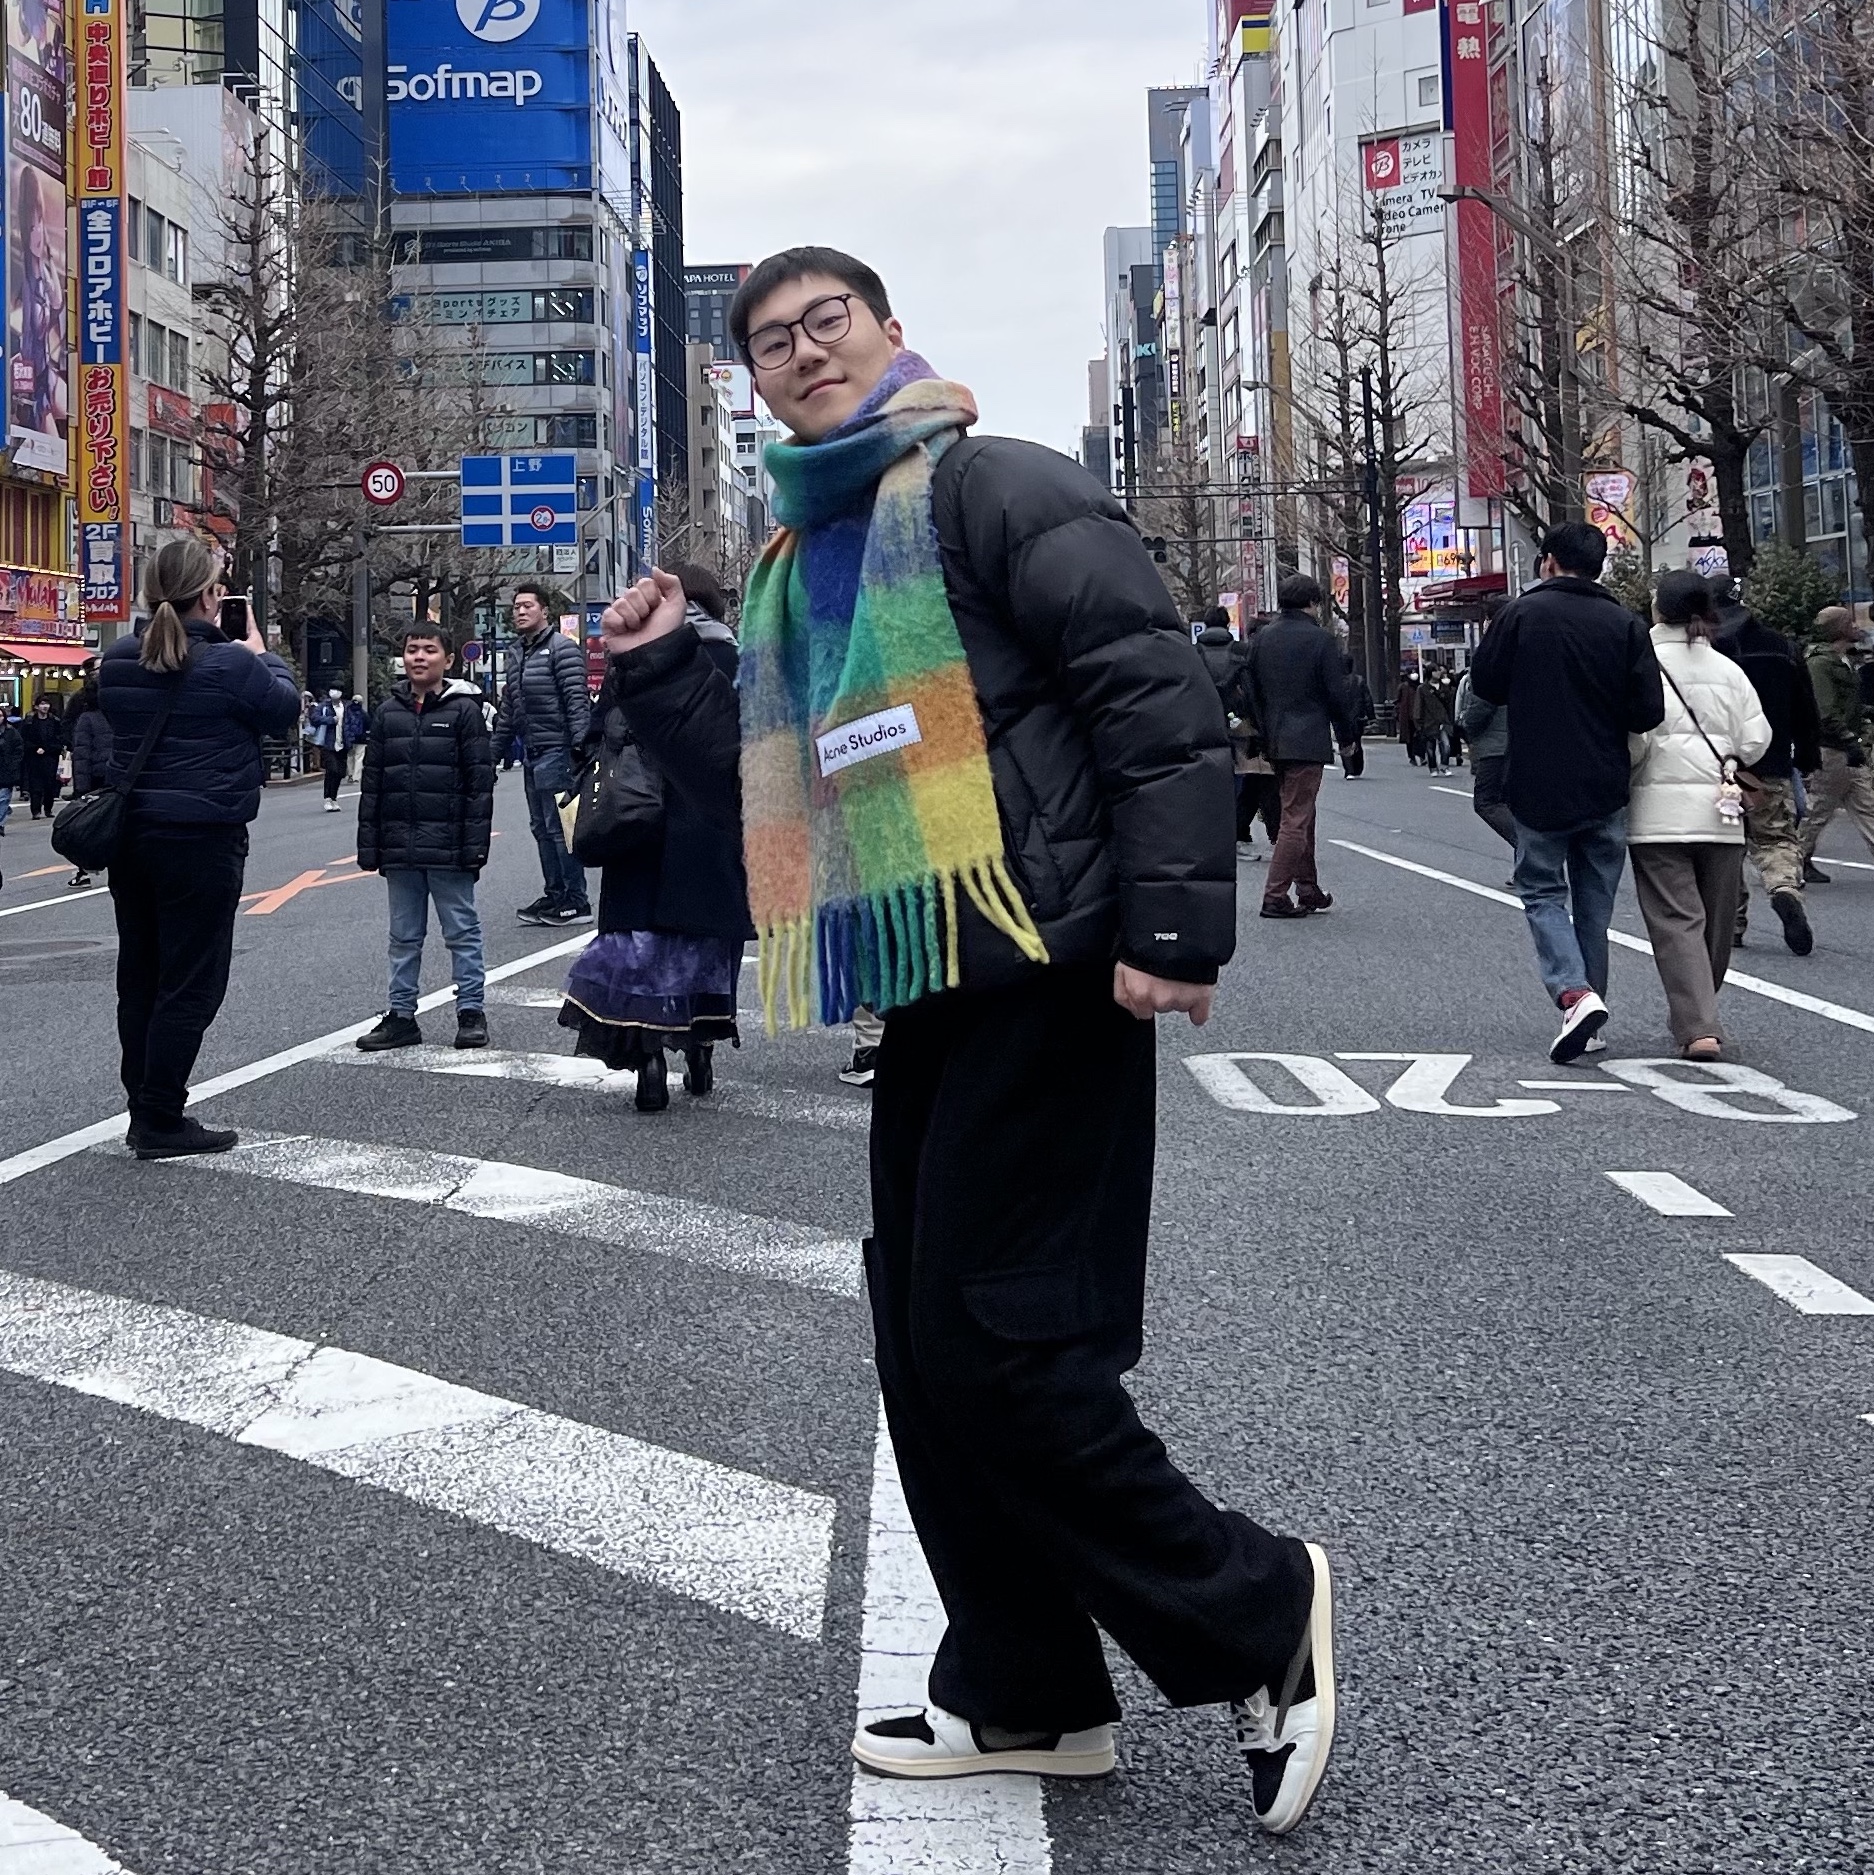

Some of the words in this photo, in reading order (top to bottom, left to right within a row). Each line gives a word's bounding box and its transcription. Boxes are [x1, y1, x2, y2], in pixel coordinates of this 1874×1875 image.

[386, 63, 543, 106] Sofmap
[86, 21, 111, 191] 中央通りホビー館
[1403, 138, 1431, 153] カメラ
[1403, 154, 1432, 169] テレビ
[1421, 188, 1435, 200] TV
[1408, 204, 1444, 217] Camer
[703, 272, 736, 283] HOTEL
[87, 209, 113, 363] 全フロアホビー
[512, 458, 543, 472] 上野
[372, 474, 395, 493] 50
[85, 523, 118, 540] 2F
[642, 506, 653, 569] Sofmap
[88, 541, 116, 585] 買取
[86, 586, 119, 600] フロア
[1194, 625, 1203, 636] P
[823, 743, 848, 762] Acne
[849, 723, 907, 750] Studios
